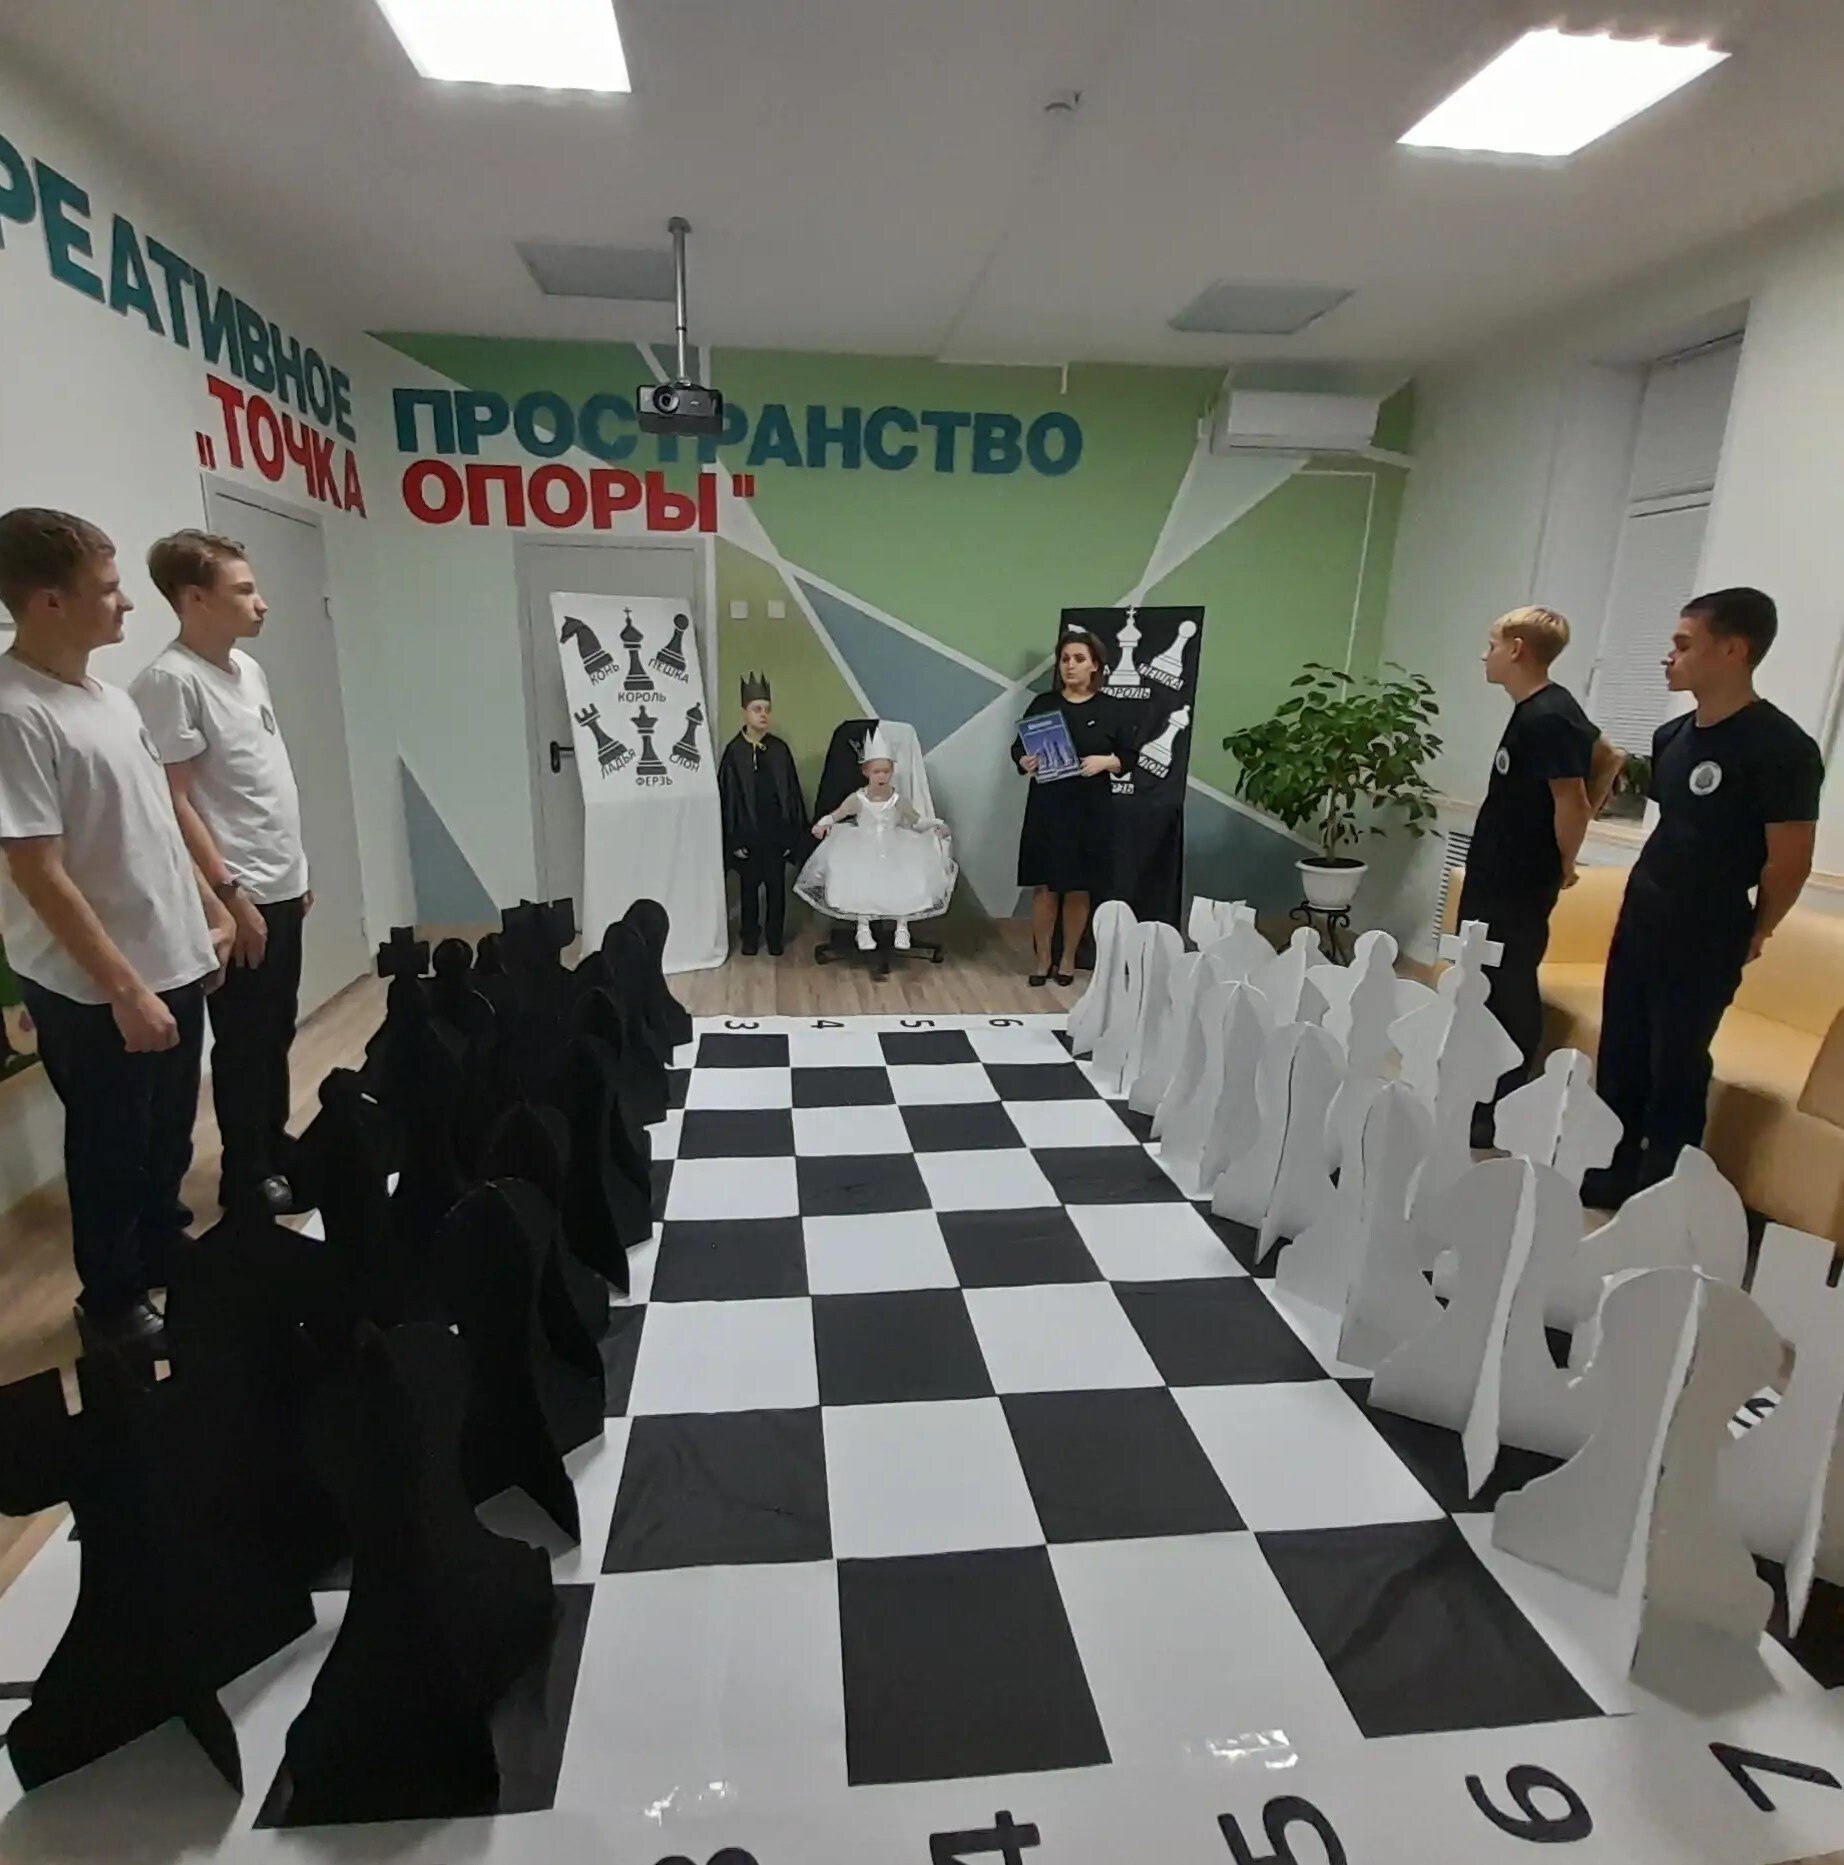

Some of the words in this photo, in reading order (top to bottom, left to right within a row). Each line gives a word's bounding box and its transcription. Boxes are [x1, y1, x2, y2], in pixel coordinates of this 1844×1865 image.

[402, 460, 755, 533] ОПОРЫ"
[590, 663, 620, 686] КОНЬ
[648, 658, 689, 685] ПЕШКА
[618, 691, 667, 704] КОРОЛЬ
[1101, 687, 1151, 699] ОРОЛЬ
[601, 748, 637, 779] ЛАДЬЯ
[669, 752, 701, 773] СЛОН
[635, 776, 674, 787] ФЕРЗЬ
[724, 1019, 760, 1030] 3
[810, 1019, 845, 1029] 4
[900, 1018, 935, 1028] 5
[988, 1018, 1024, 1027] 6
[1708, 1741, 1842, 1812] 7
[1465, 1764, 1592, 1843] 6
[1217, 1795, 1347, 1865] 5
